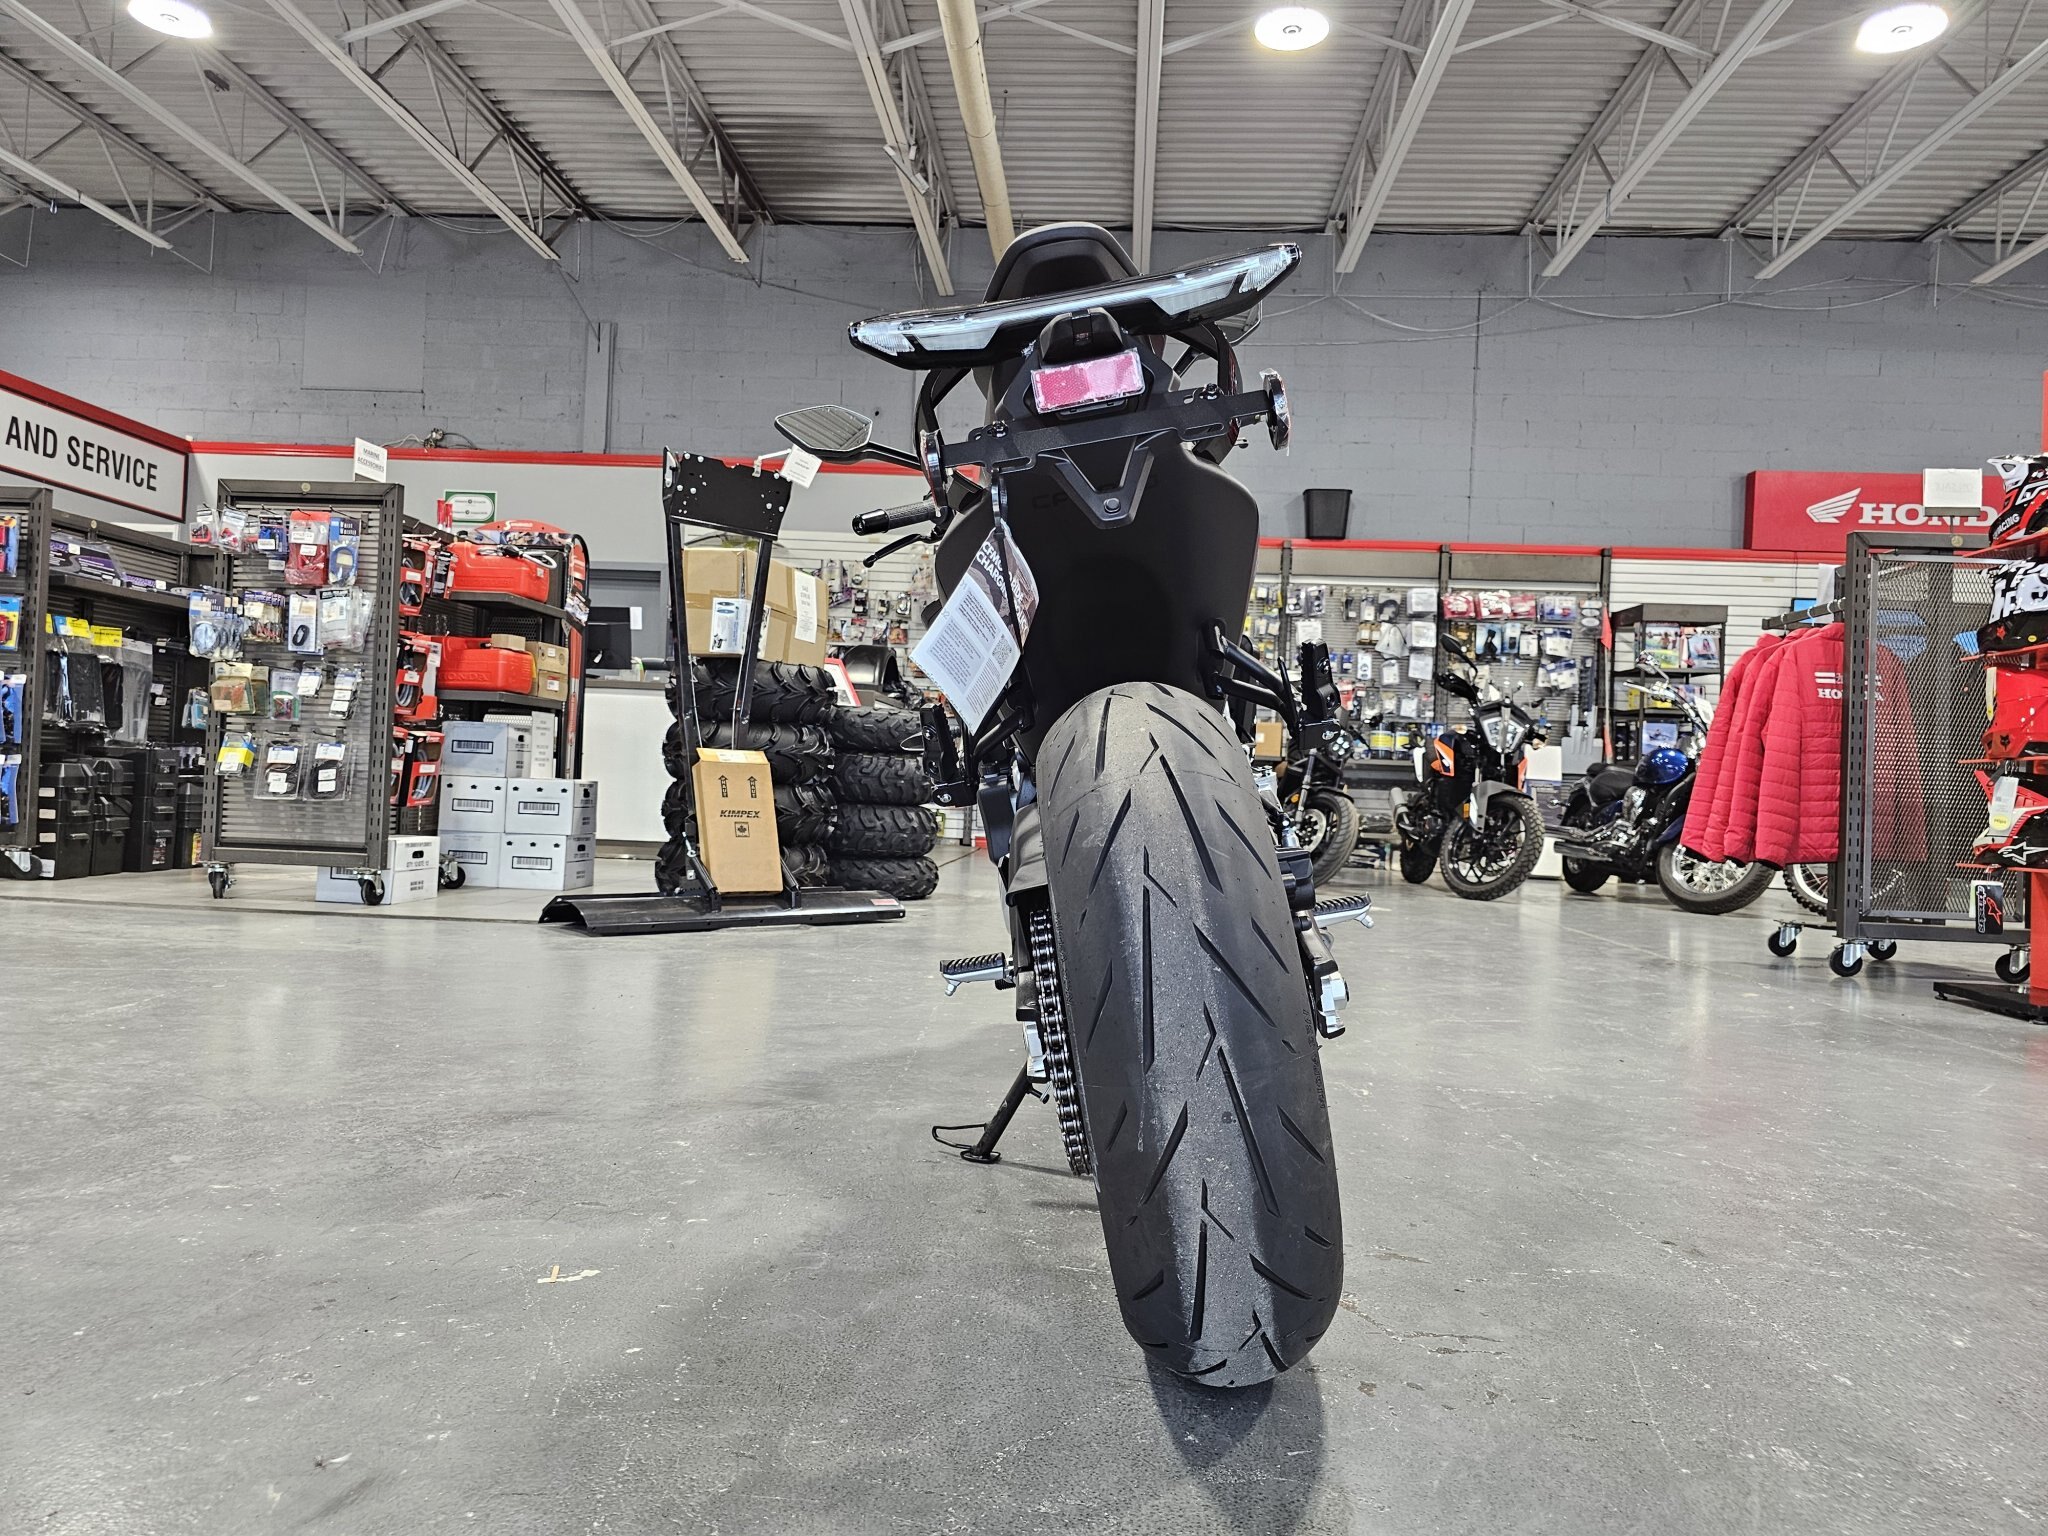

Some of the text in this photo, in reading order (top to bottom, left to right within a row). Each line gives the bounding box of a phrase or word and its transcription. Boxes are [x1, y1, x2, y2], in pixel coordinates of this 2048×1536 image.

[5, 415, 158, 492] AND SERVICE
[720, 809, 761, 819] KIMPEX
